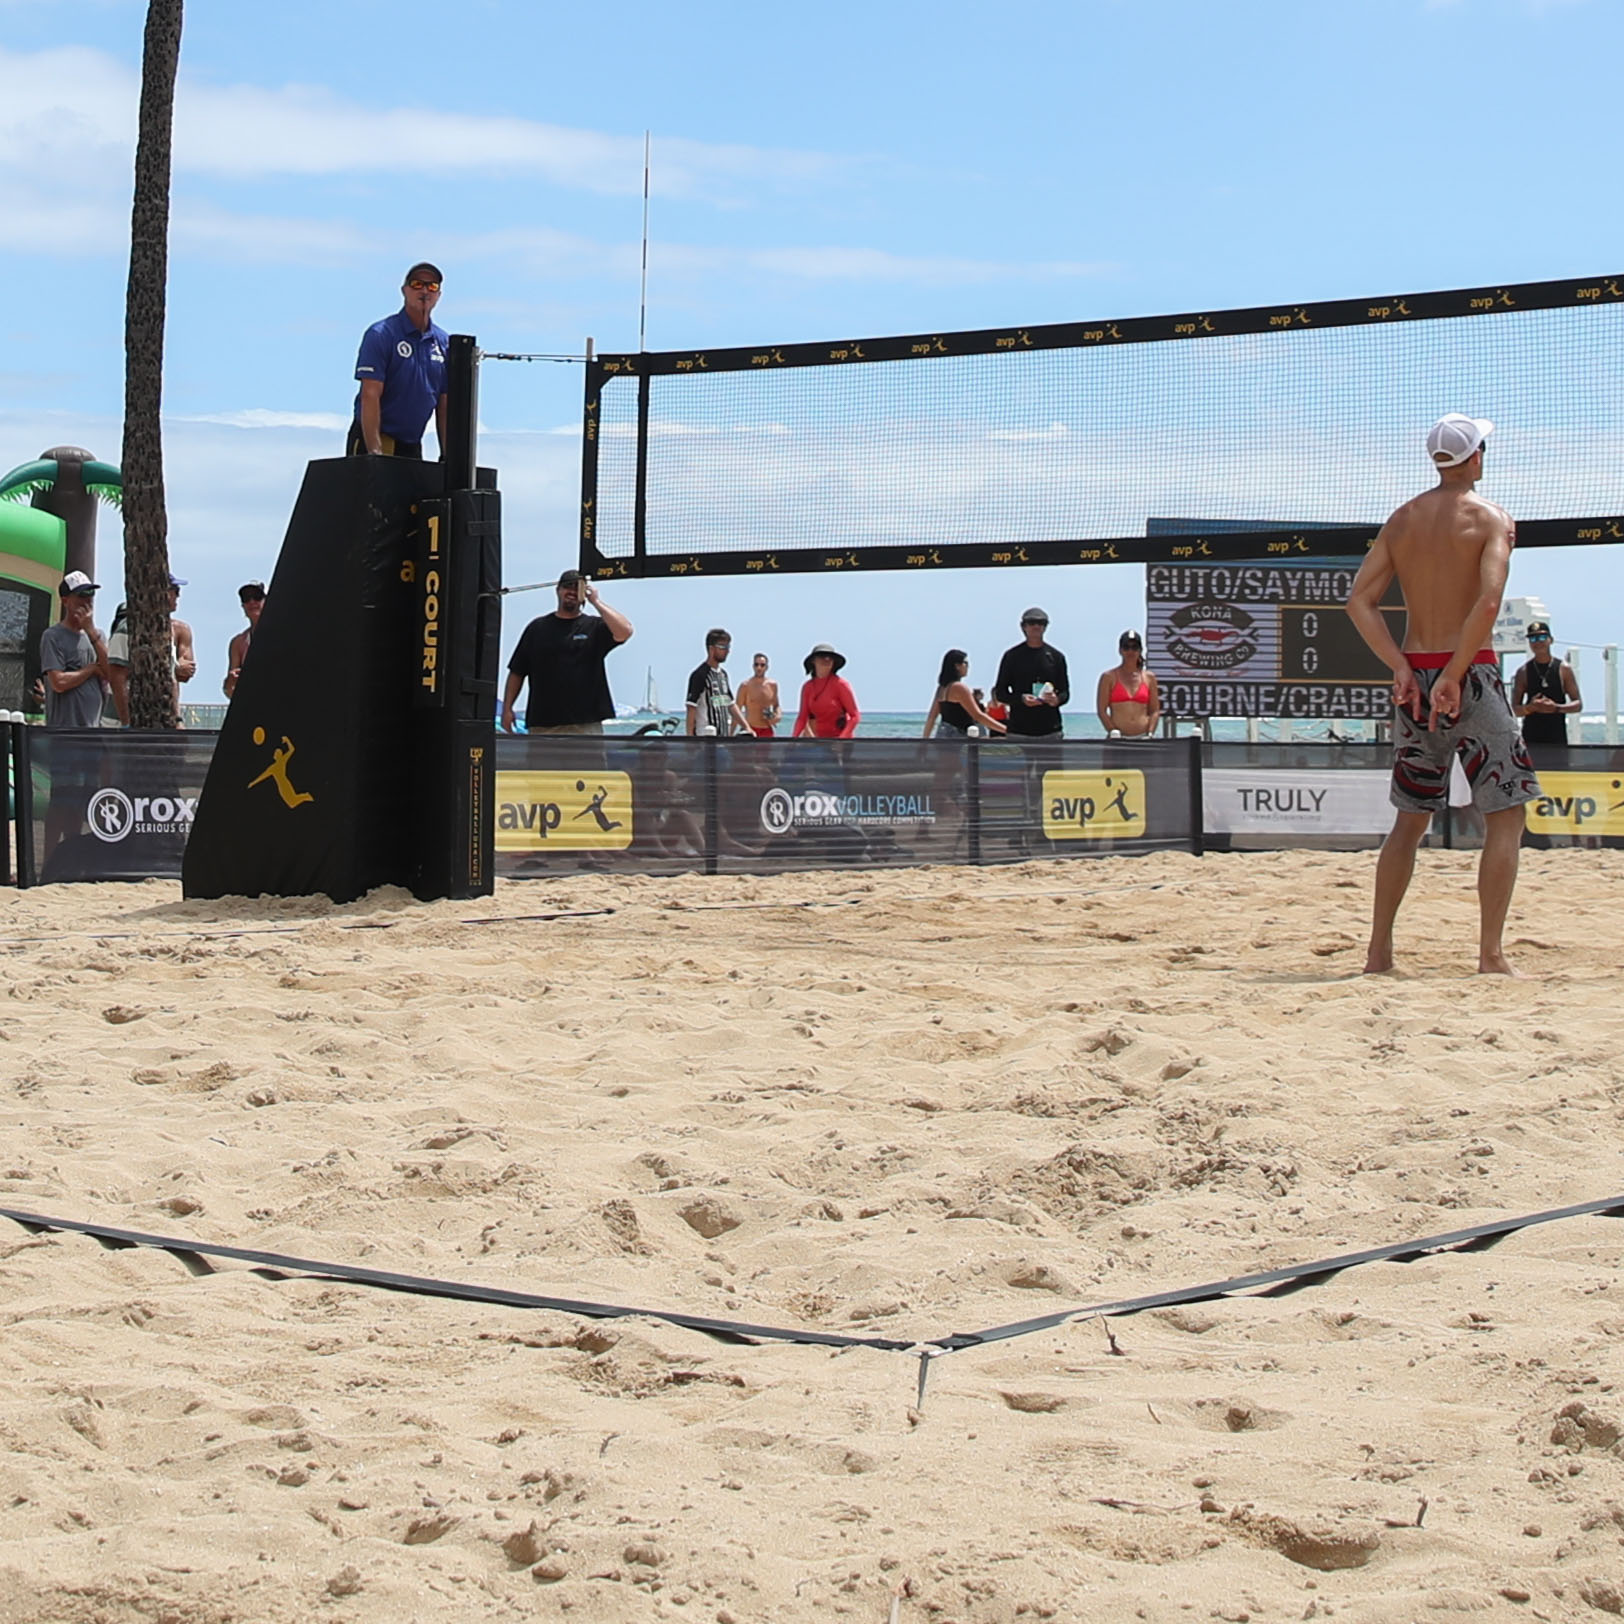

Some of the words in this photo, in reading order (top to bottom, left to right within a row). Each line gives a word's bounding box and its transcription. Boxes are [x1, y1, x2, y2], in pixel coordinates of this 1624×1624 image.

[1577, 288, 1602, 300] avp
[1472, 298, 1494, 309] avp
[1369, 308, 1392, 319] avp
[1269, 316, 1293, 327] avp
[1176, 324, 1196, 334] avp
[1084, 330, 1104, 341] avp
[996, 338, 1016, 348] avp
[912, 344, 931, 354] avp
[752, 356, 770, 365] avp
[832, 350, 848, 360] avp
[604, 363, 622, 373] avp
[677, 361, 693, 370] avp
[427, 515, 439, 552] 1
[1578, 528, 1602, 541] avp
[1172, 547, 1194, 558] avp
[1268, 543, 1291, 554] avp
[907, 555, 927, 567] avp
[993, 552, 1012, 564] avp
[1081, 550, 1102, 562] avp
[672, 563, 688, 574] avp
[747, 560, 764, 571] avp
[827, 558, 844, 568] avp
[597, 568, 614, 578] avp
[1302, 612, 1318, 637] 0
[422, 570, 440, 692] COURT
[1302, 647, 1318, 673] 0
[1237, 789, 1327, 811] TRULY
[1050, 797, 1095, 828] avp
[1536, 796, 1596, 825] avp
[498, 802, 561, 838] avp
[135, 823, 175, 833] SERIOUS
